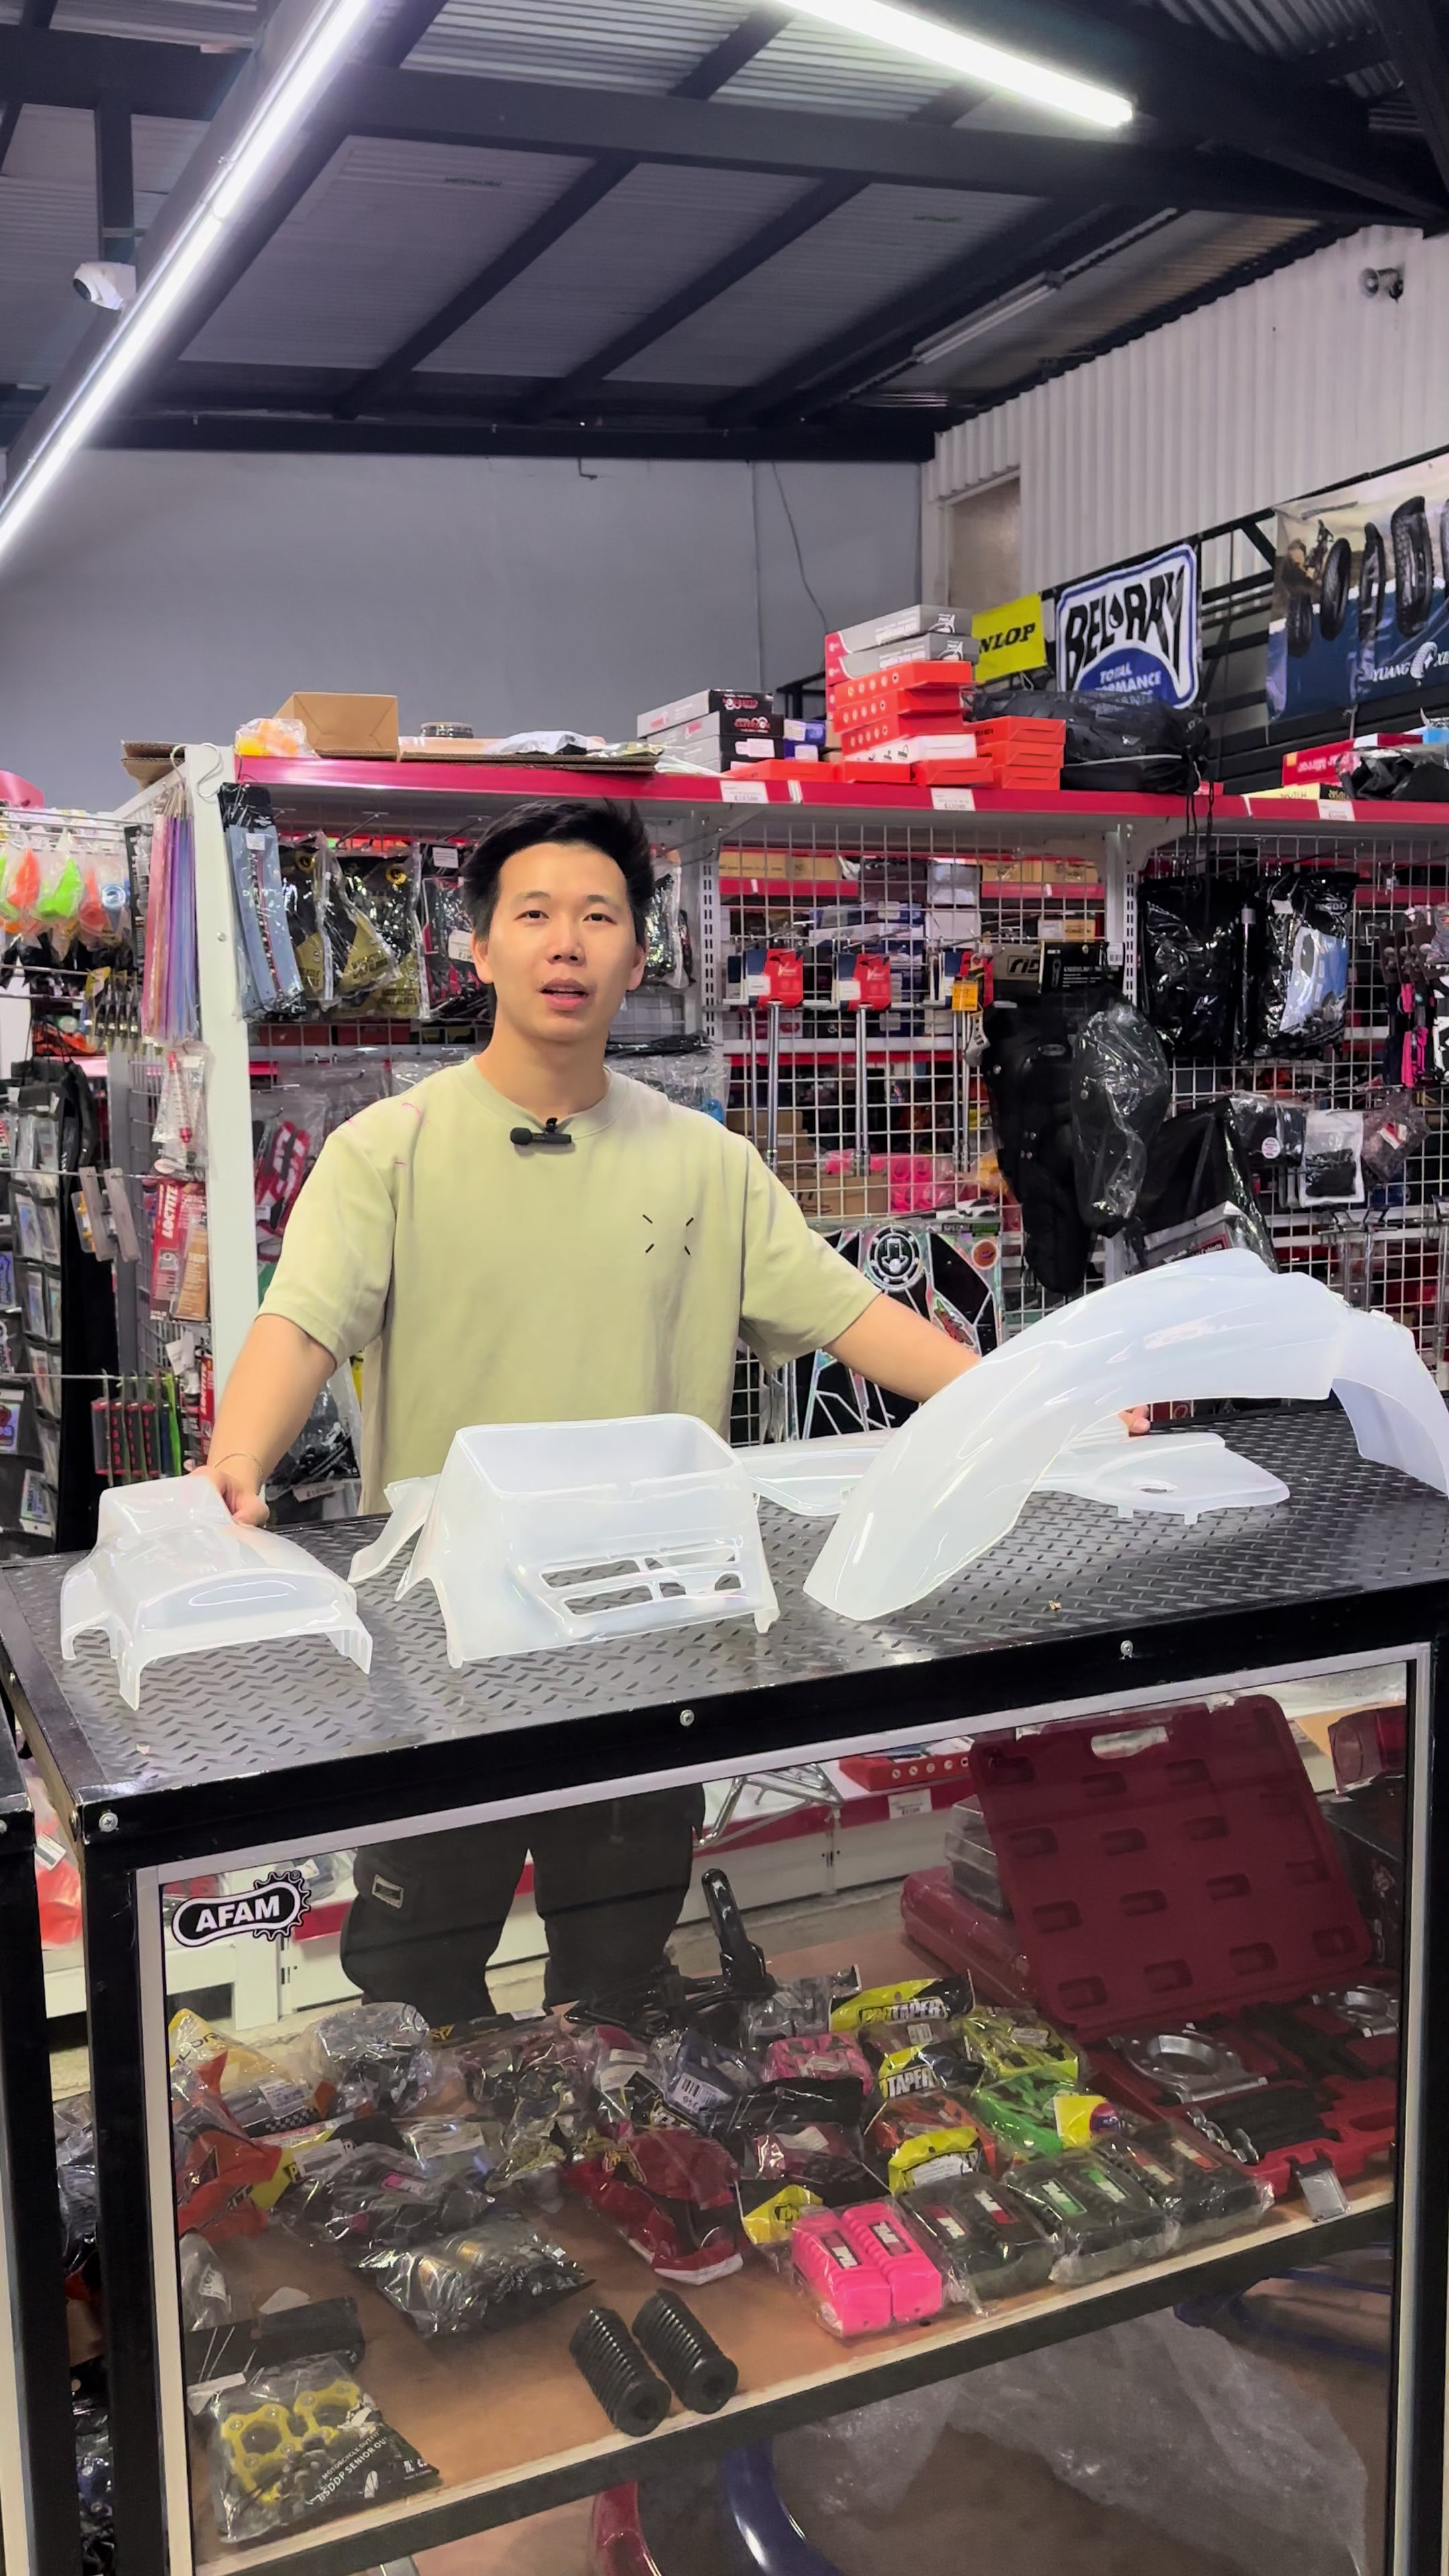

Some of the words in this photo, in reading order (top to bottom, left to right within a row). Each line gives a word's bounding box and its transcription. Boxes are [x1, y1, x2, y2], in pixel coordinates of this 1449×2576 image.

[979, 622, 1036, 653] NLOP
[162, 1184, 178, 1239] LOCTITE
[195, 1895, 280, 1933] AFAM
[321, 2446, 360, 2480] MOTORCYCLE
[345, 2447, 375, 2474] SENIOR
